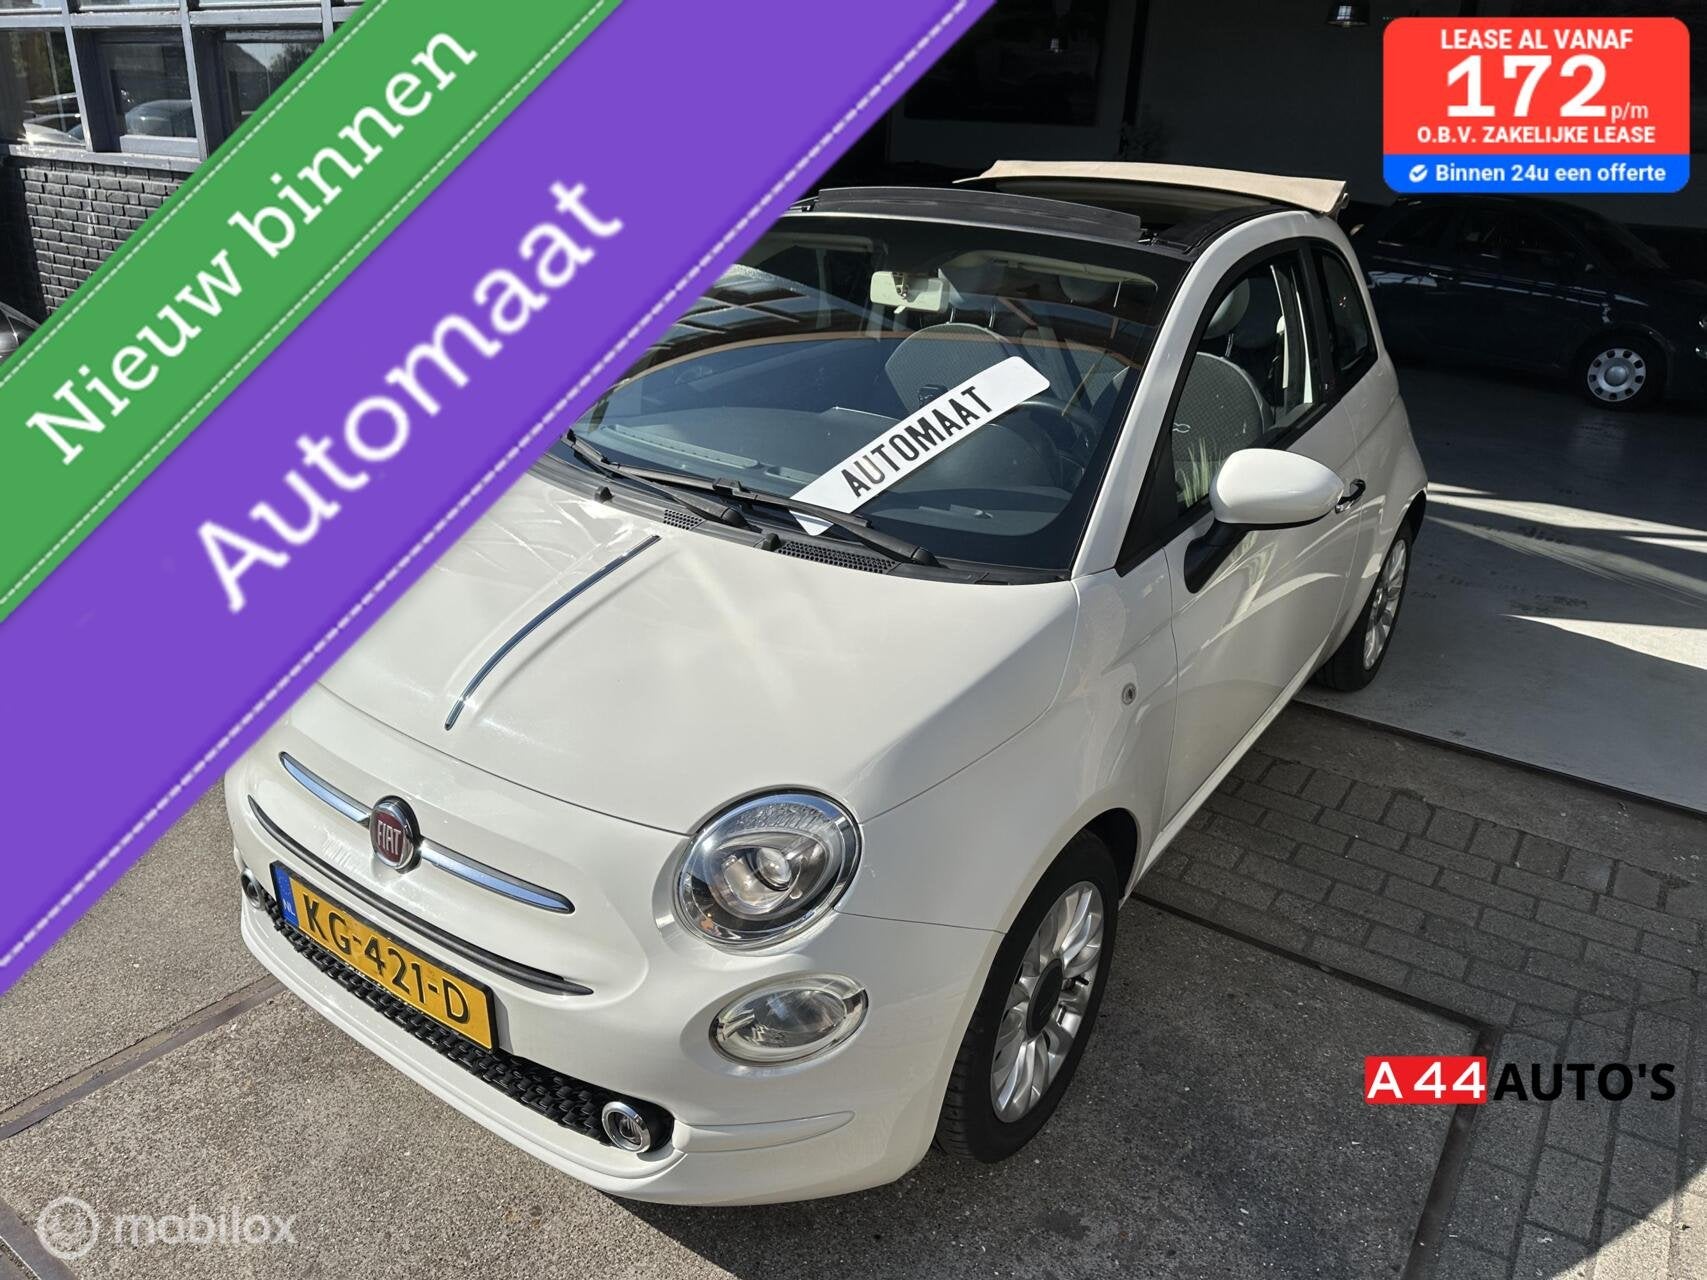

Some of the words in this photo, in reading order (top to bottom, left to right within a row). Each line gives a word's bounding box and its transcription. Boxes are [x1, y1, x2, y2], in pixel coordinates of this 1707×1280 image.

[841, 386, 993, 497] AUTOMAAT
[376, 819, 402, 855] FIAT
[282, 897, 297, 917] NL
[302, 893, 471, 1025] KG-421-D
